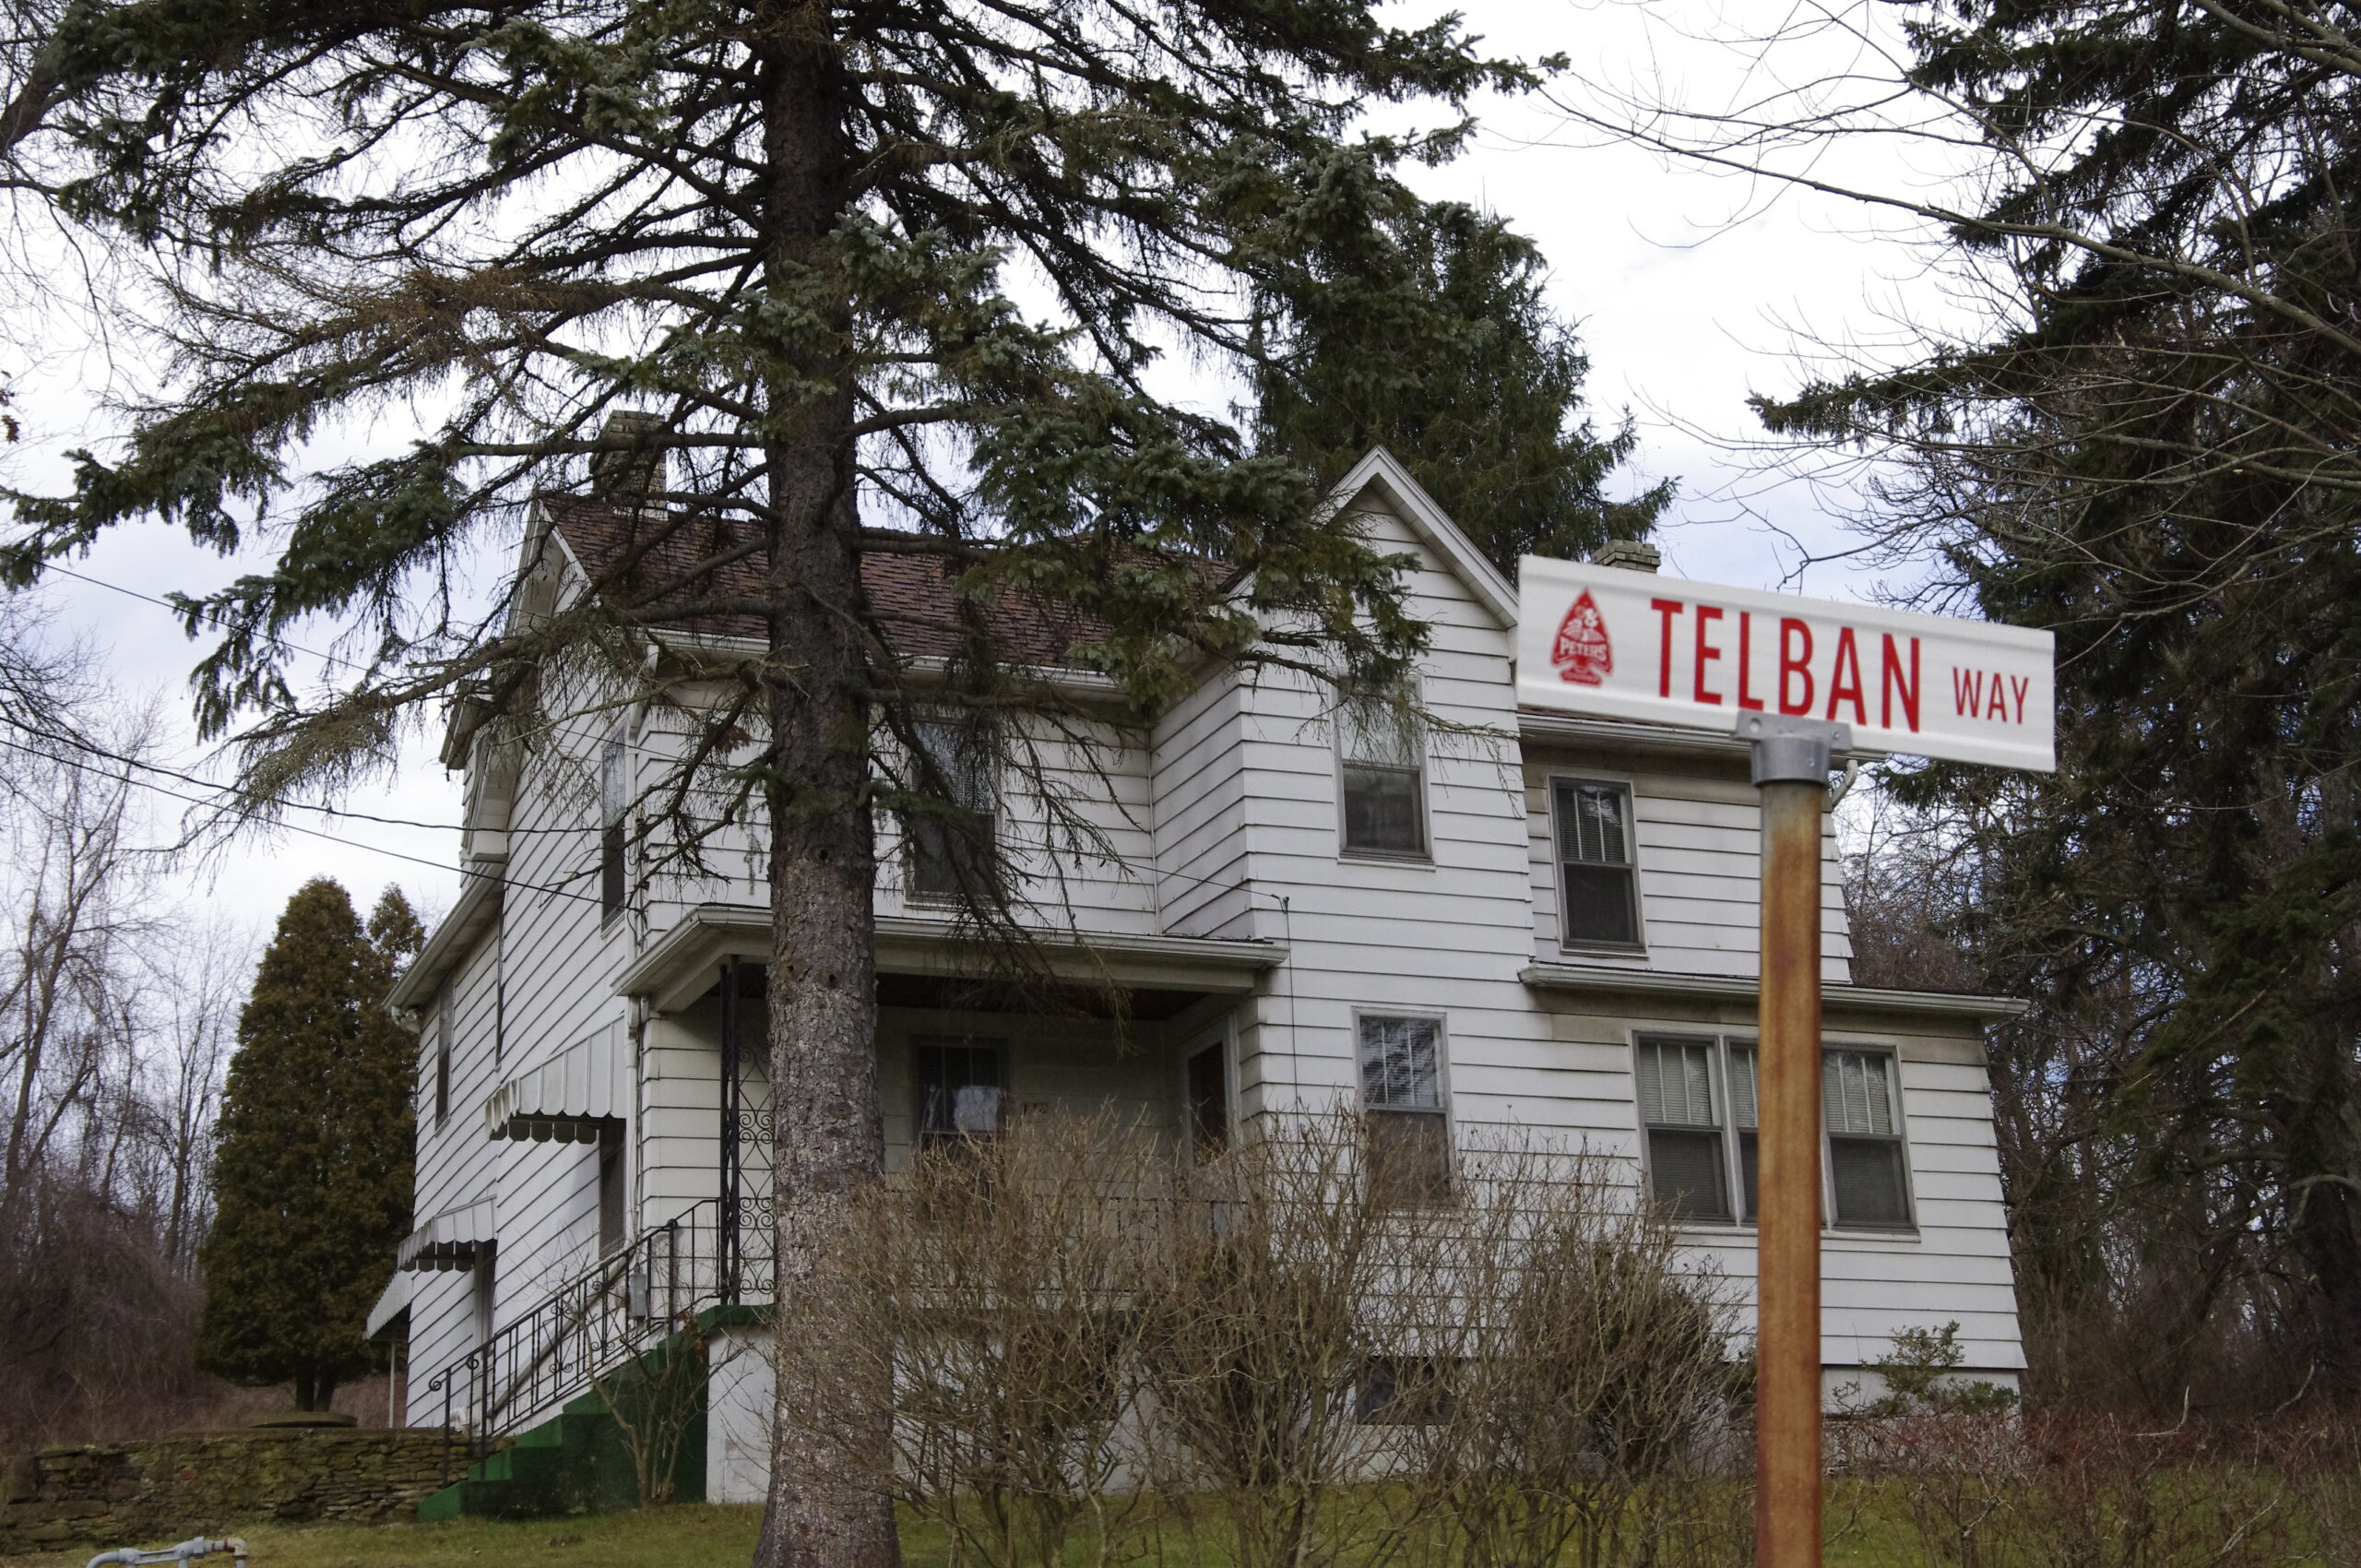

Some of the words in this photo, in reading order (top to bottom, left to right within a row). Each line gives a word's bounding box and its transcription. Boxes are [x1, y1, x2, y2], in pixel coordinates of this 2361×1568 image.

[1560, 636, 1607, 661] PETERS
[1652, 598, 1920, 733] TELBAN
[1952, 666, 2029, 724] WAY
